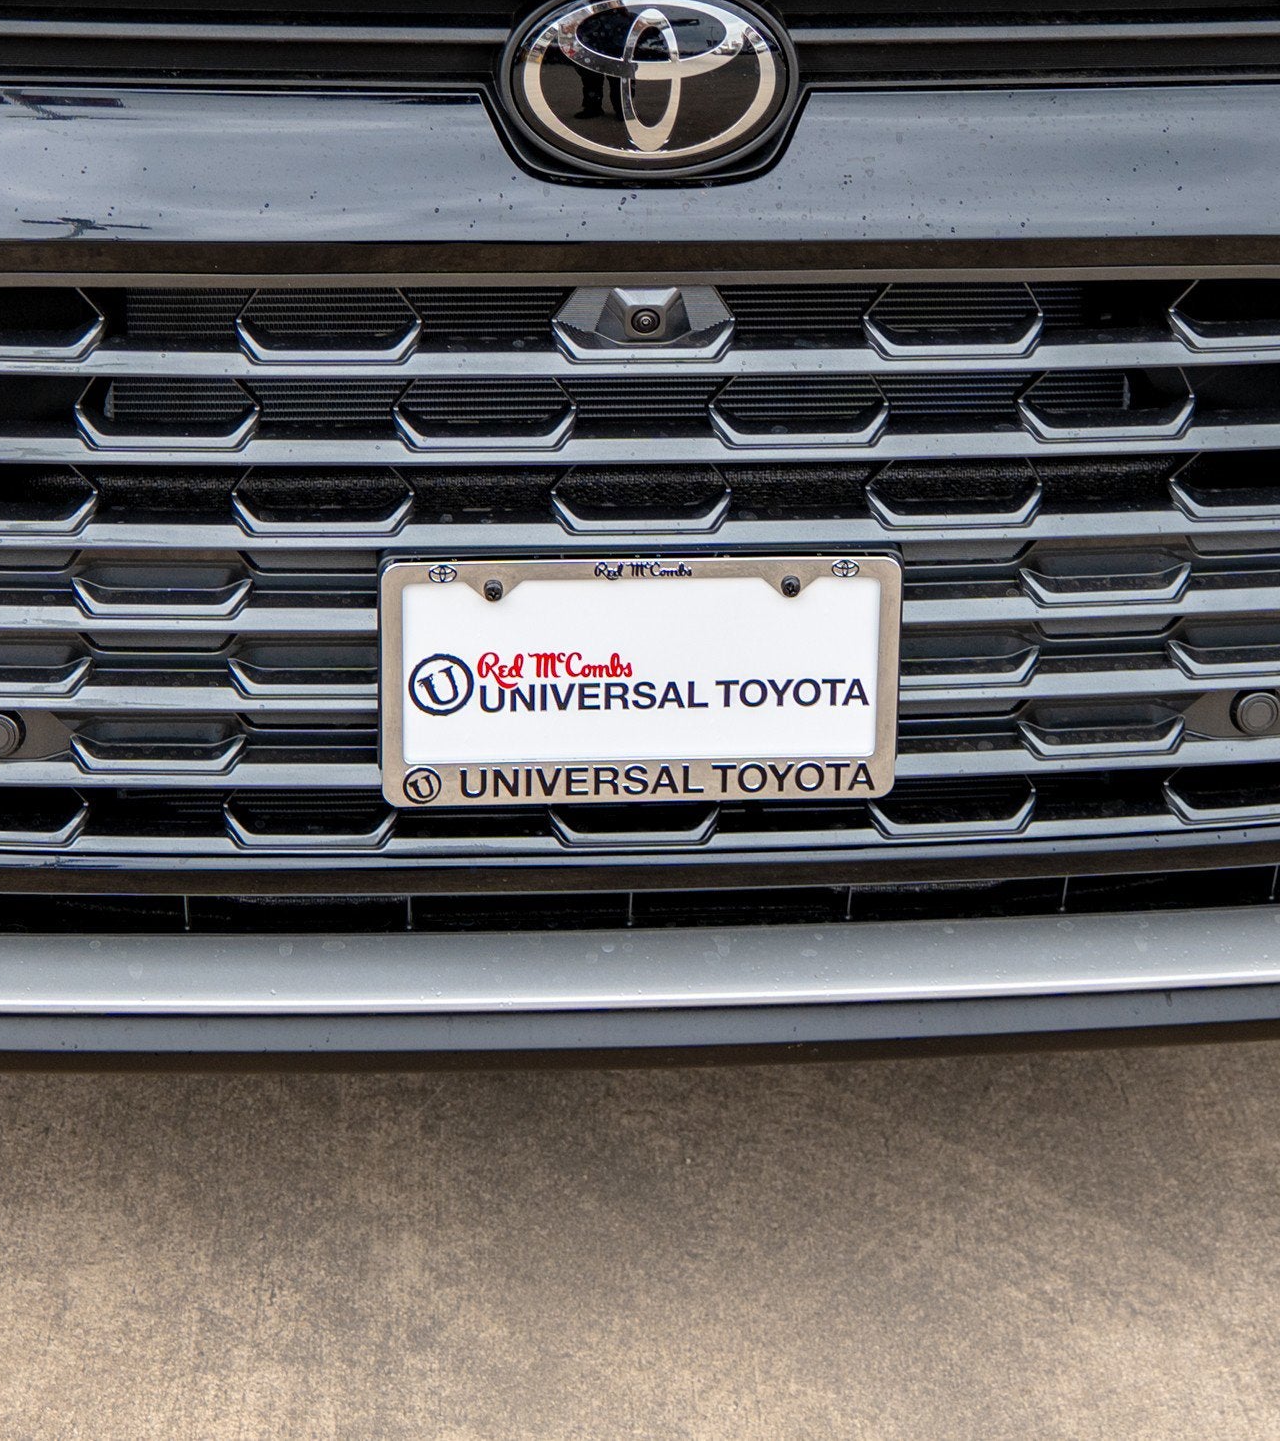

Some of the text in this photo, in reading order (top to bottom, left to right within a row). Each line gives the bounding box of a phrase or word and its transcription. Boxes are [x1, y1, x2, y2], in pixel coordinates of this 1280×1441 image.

[625, 561, 693, 577] McCombs
[477, 652, 633, 689] Red McCombs
[479, 677, 870, 713] UNIVERSAL TOYOTA
[459, 763, 705, 799] UNIVERSAL
[711, 760, 876, 793] TOYOTA
